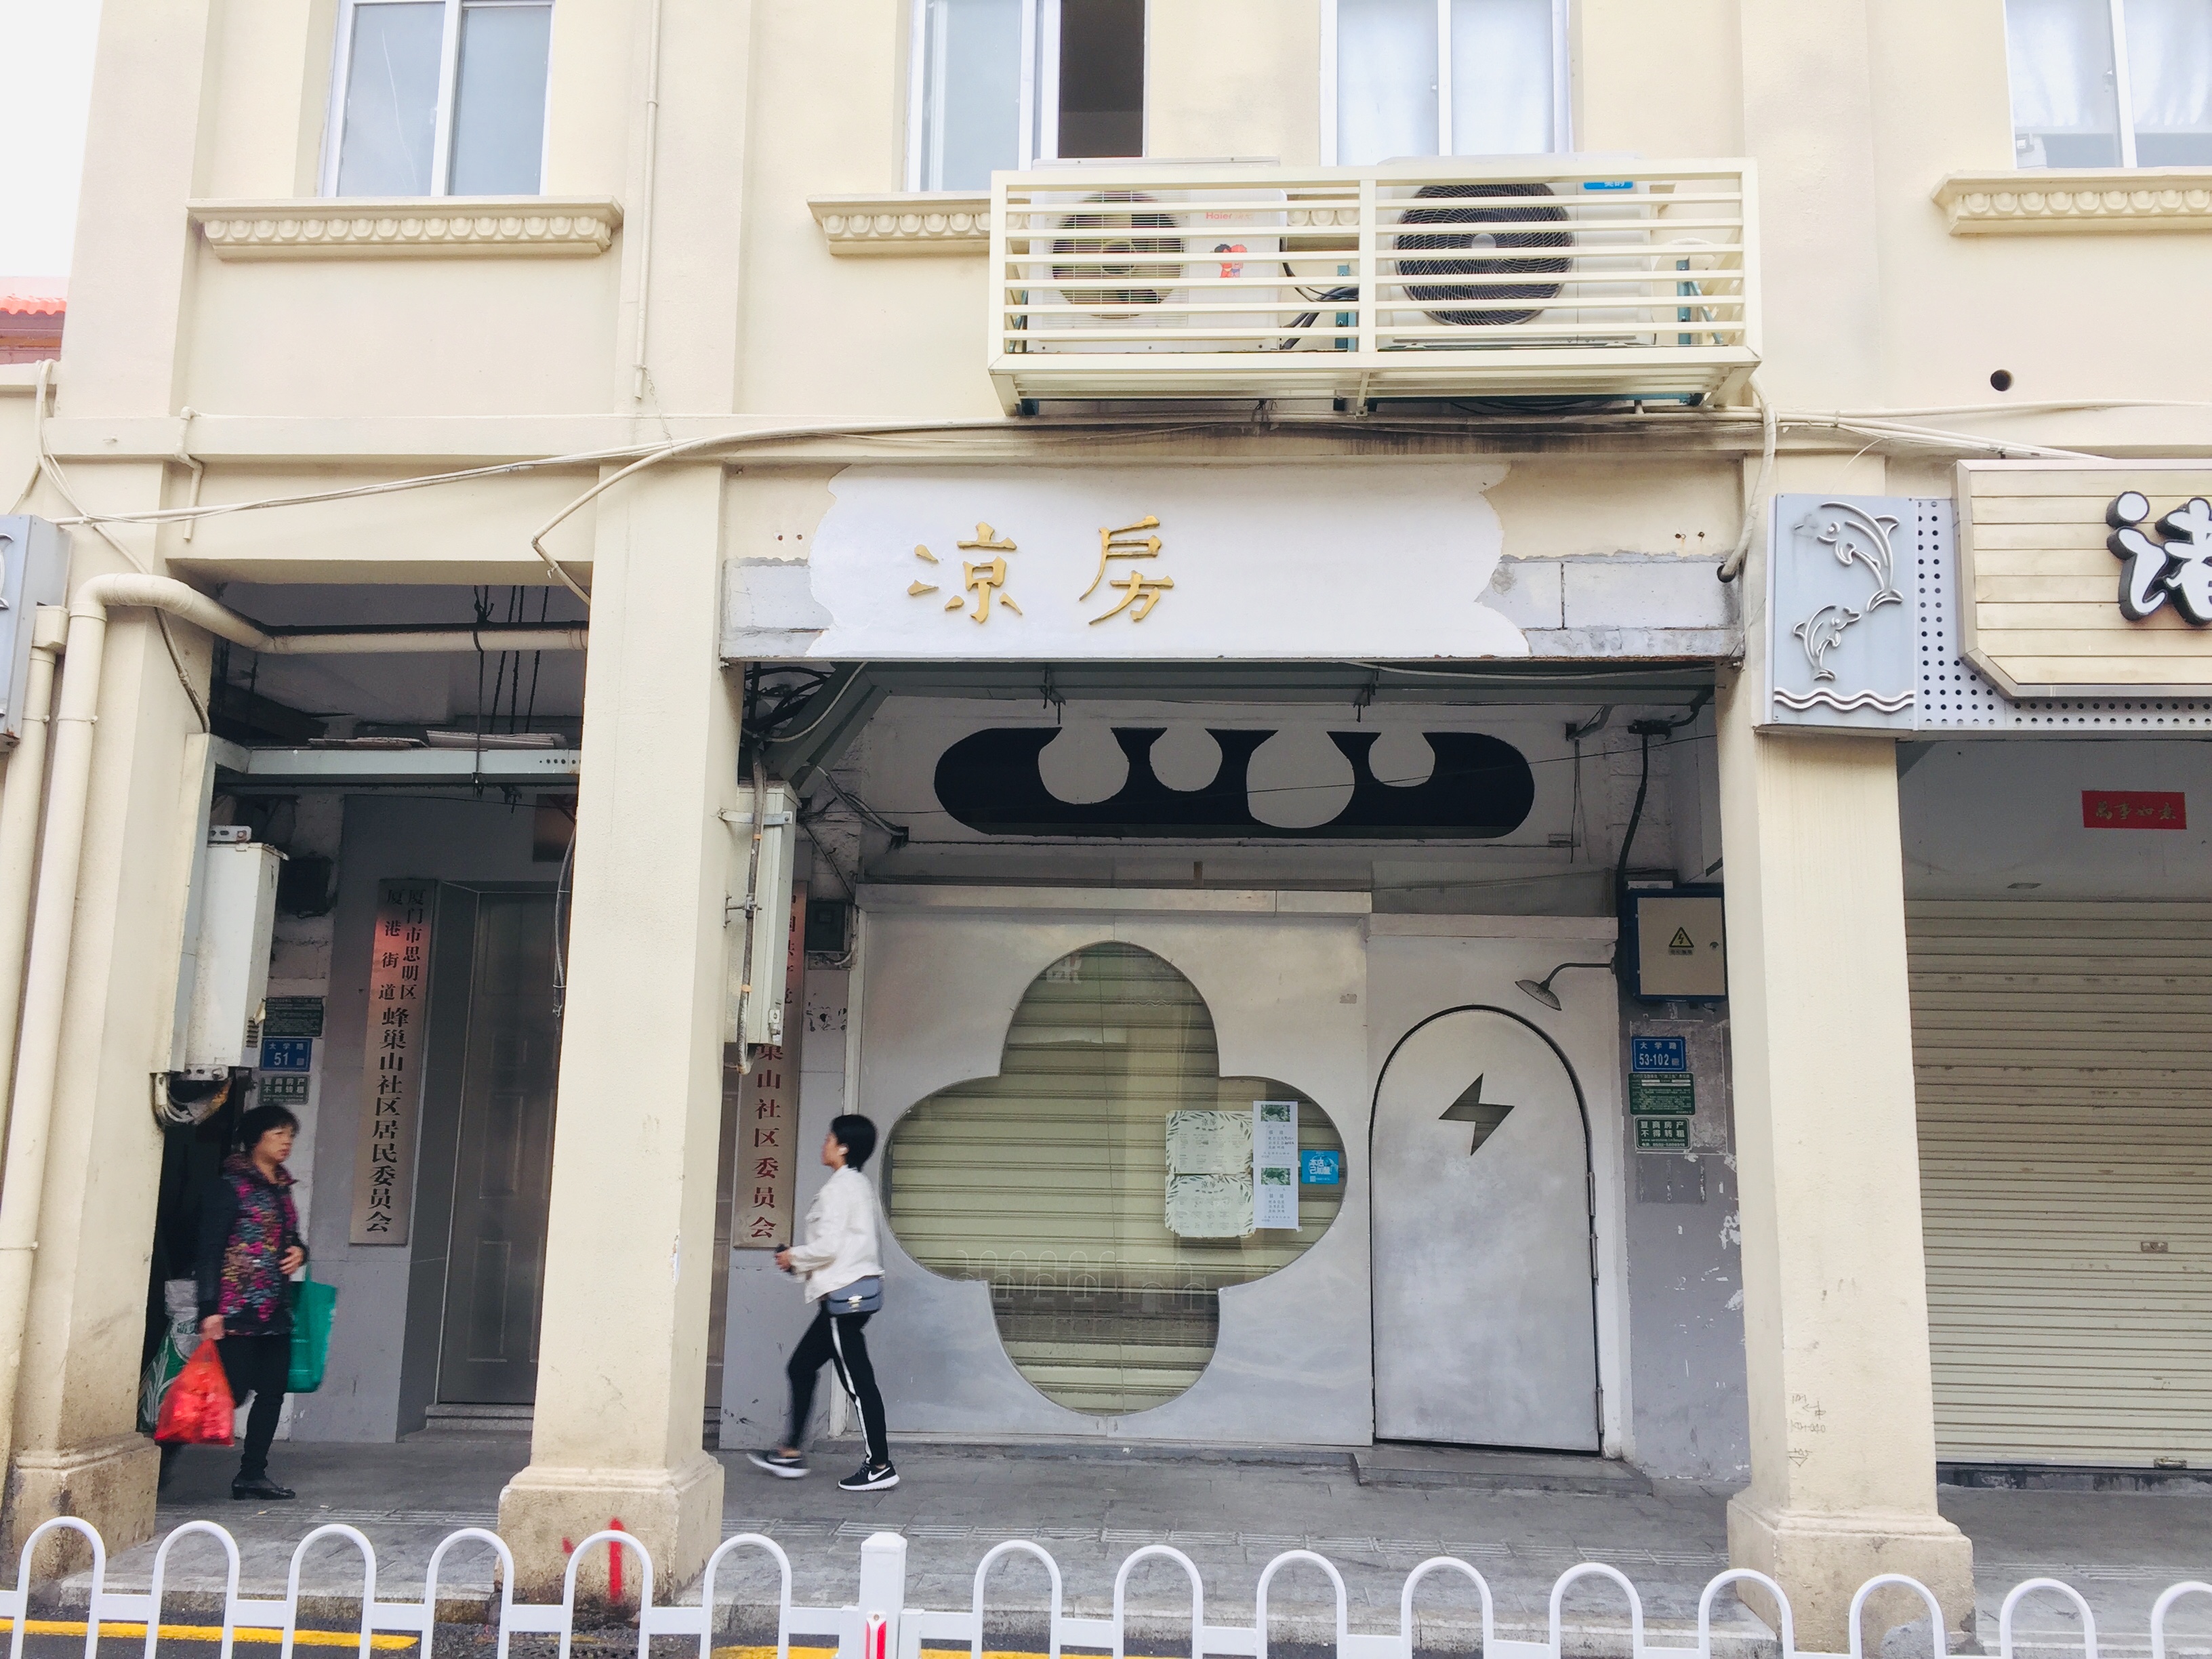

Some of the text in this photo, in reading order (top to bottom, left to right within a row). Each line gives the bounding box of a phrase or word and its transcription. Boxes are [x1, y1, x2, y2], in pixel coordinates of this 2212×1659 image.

[1206, 211, 1232, 220] Haier
[378, 889, 405, 1000] 厦港街道
[400, 889, 426, 1000] 厦门市思明区
[274, 1052, 289, 1066] 51
[366, 1007, 409, 1232] 蜂巢山社区居民委员会
